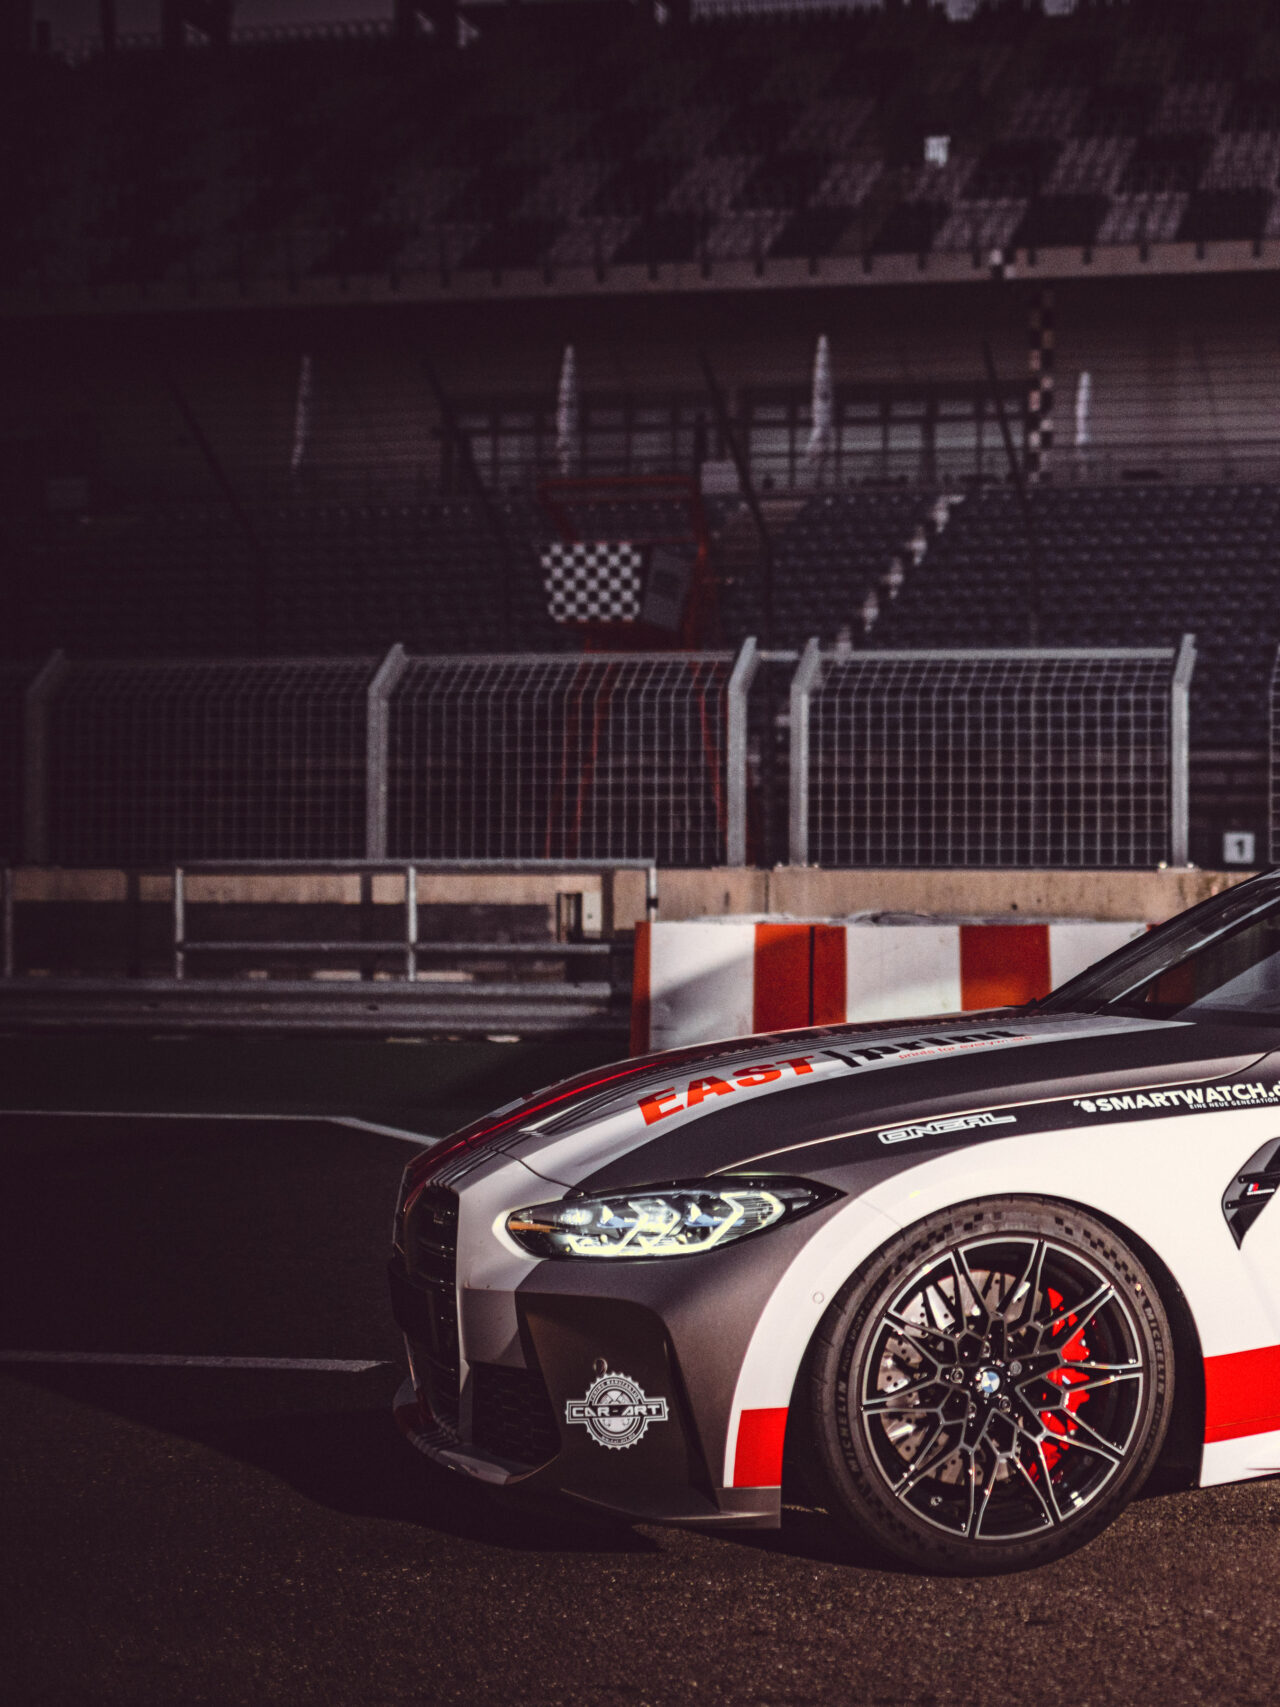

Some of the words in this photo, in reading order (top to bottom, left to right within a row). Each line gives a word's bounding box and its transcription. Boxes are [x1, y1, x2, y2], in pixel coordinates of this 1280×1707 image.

[1235, 839, 1245, 858] 1
[638, 1055, 815, 1127] EAST
[1208, 1100, 1230, 1109] NEUE
[1231, 1097, 1279, 1107] GENERATION
[1144, 1306, 1165, 1396] MICHELIN
[571, 1404, 660, 1417] CAR-ART
